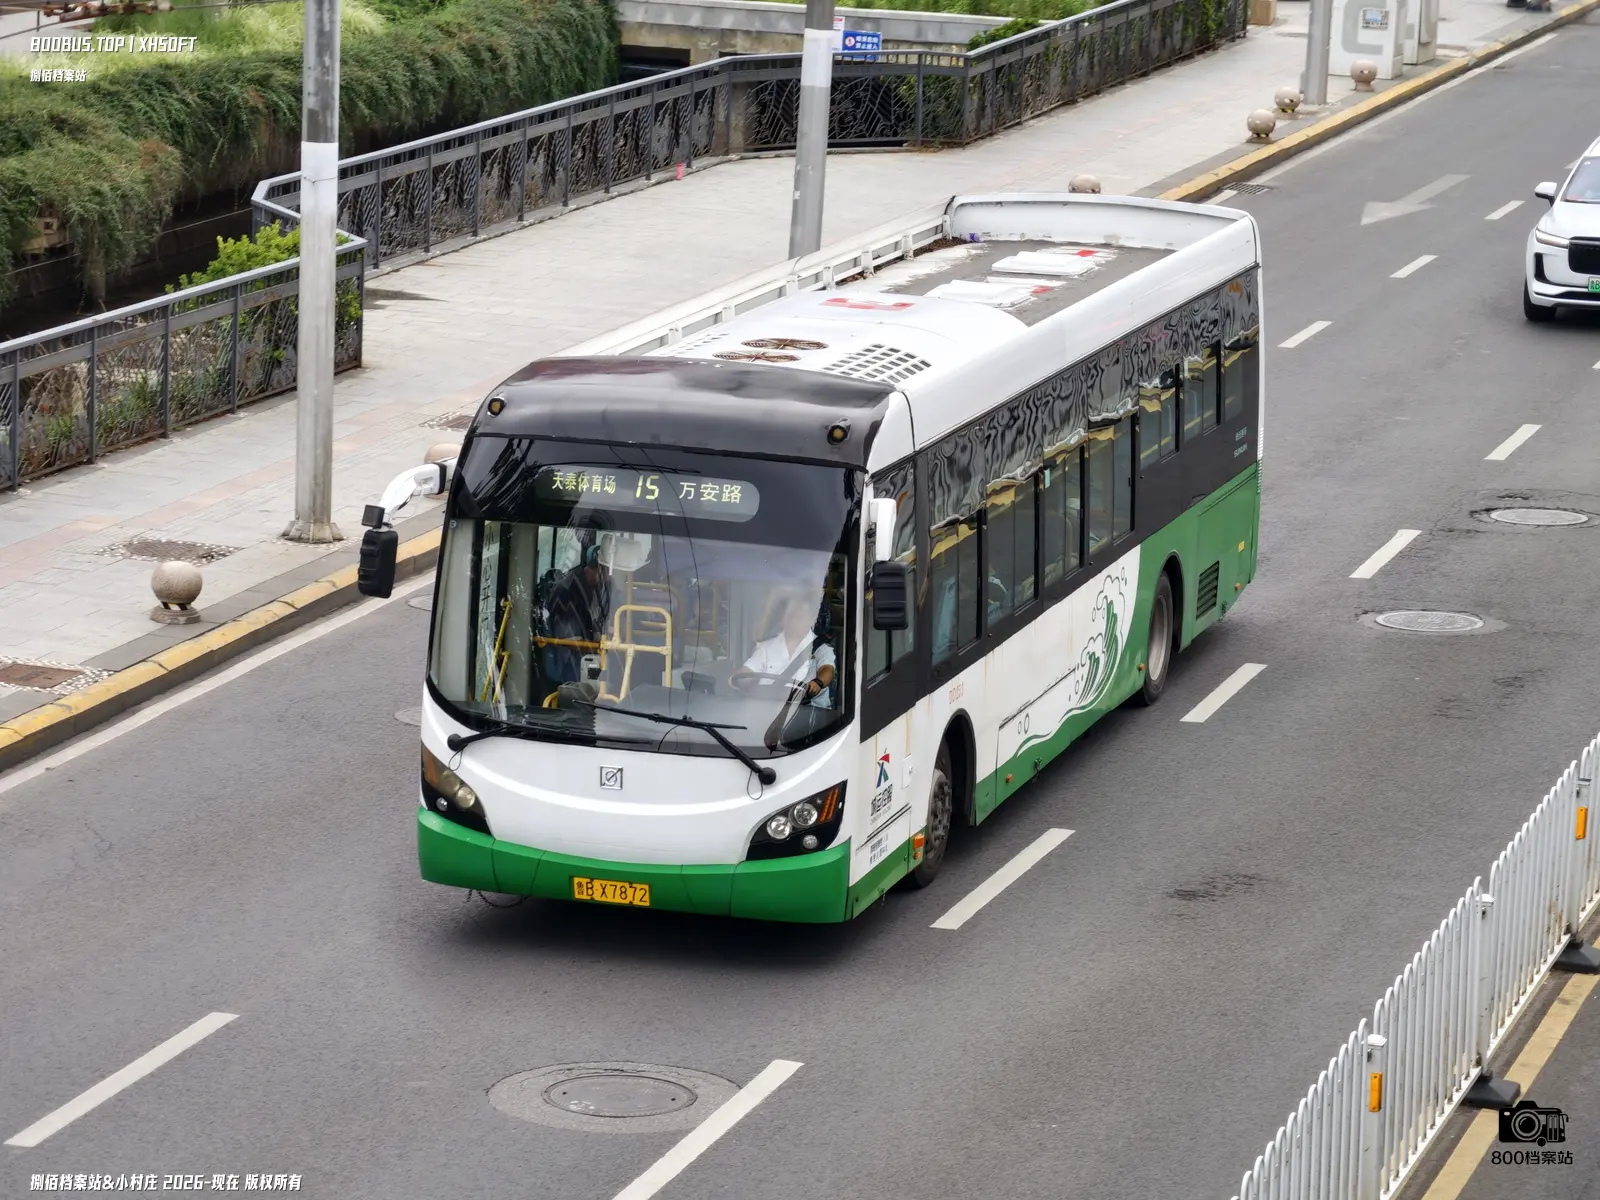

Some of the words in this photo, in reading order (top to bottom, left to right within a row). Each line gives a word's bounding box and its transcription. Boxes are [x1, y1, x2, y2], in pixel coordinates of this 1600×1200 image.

[552, 471, 616, 494] 天泰体育场
[635, 474, 660, 500] 15
[679, 481, 742, 504] 万安路
